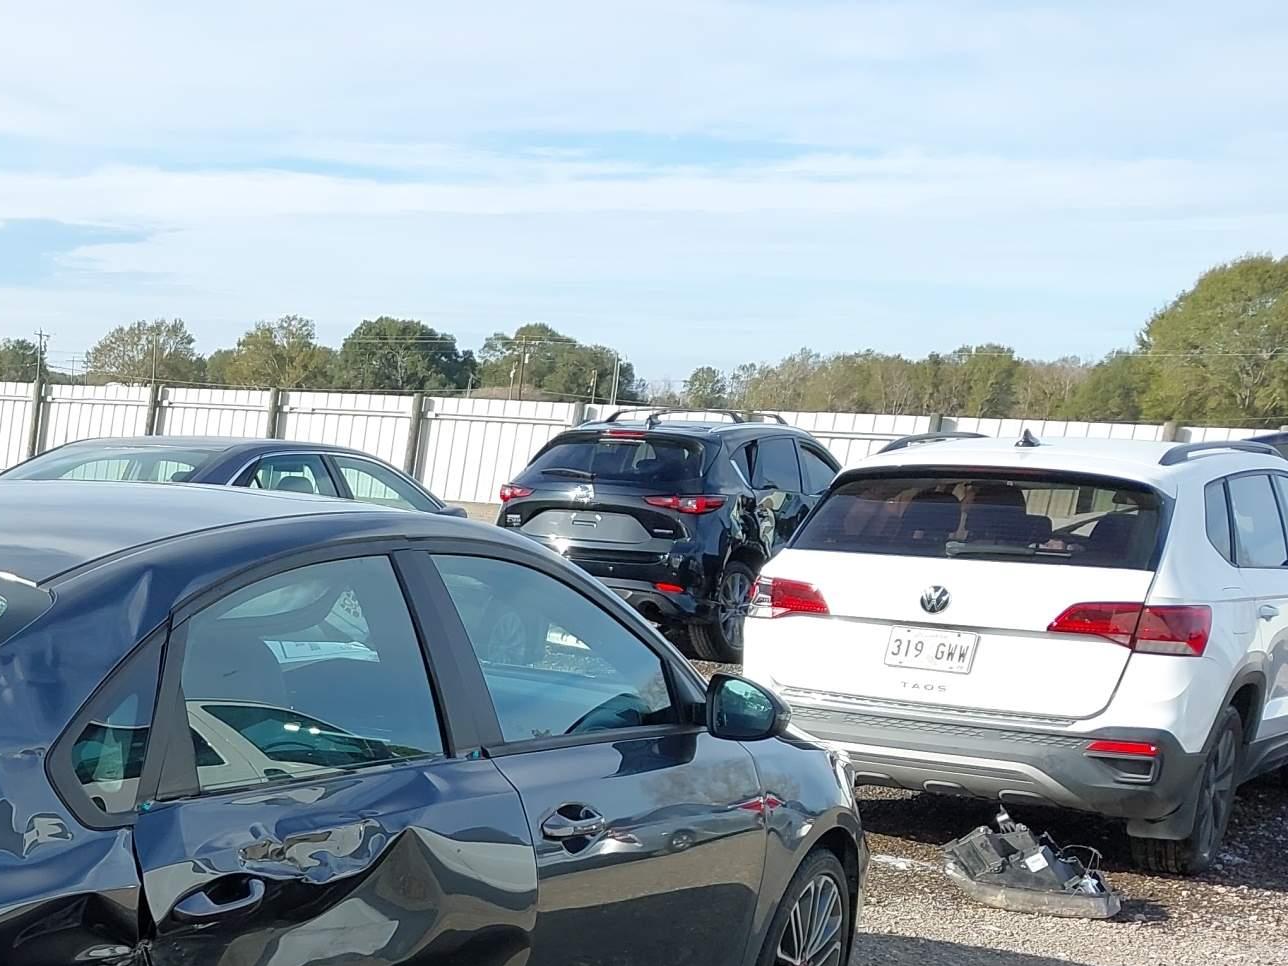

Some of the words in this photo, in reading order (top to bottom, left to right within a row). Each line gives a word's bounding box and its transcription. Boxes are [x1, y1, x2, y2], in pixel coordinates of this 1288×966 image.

[891, 638, 925, 659] 319
[934, 642, 970, 664] GWW
[901, 680, 947, 692] TAOS
